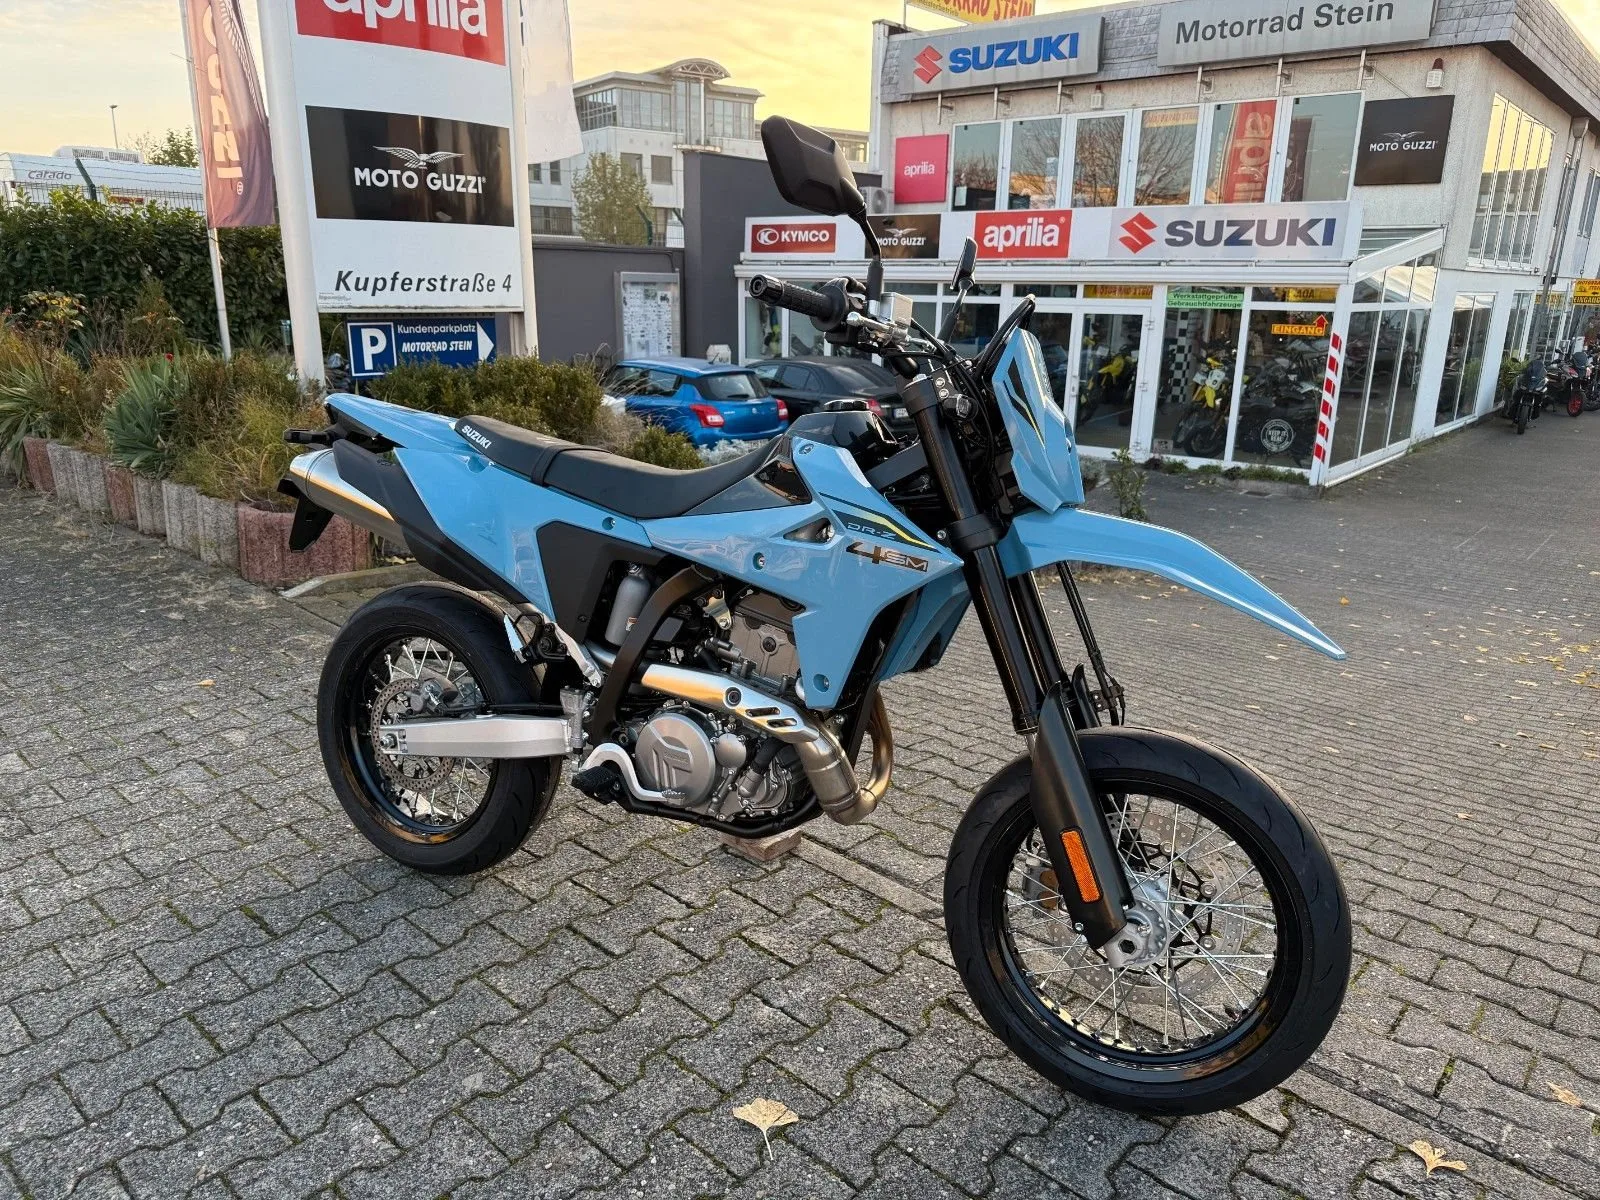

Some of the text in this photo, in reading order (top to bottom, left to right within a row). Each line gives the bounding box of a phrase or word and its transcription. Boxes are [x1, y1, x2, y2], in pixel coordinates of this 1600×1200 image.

[1176, 0, 1394, 44] Motorrad Stein
[949, 32, 1080, 74] SUZUKI
[1369, 140, 1436, 152] MOTO GUZZI
[904, 161, 935, 177] aprilia
[354, 167, 483, 194] MOTO GUZZI
[781, 230, 830, 242] KYMCO
[901, 237, 925, 246] GUZZI
[983, 217, 1060, 252] aprilia
[1164, 218, 1337, 247] SUZUKI
[335, 270, 512, 296] Kupferstraße 4
[1167, 300, 1242, 308] Gebrauchtfahrzeuge
[397, 324, 476, 337] Kundenparkplatz
[1274, 326, 1323, 335] EINGANG
[361, 328, 387, 371] P
[402, 340, 473, 353] MOTORRAD STEIN
[461, 424, 492, 449] SUZUKI
[847, 522, 897, 540] DR-Z
